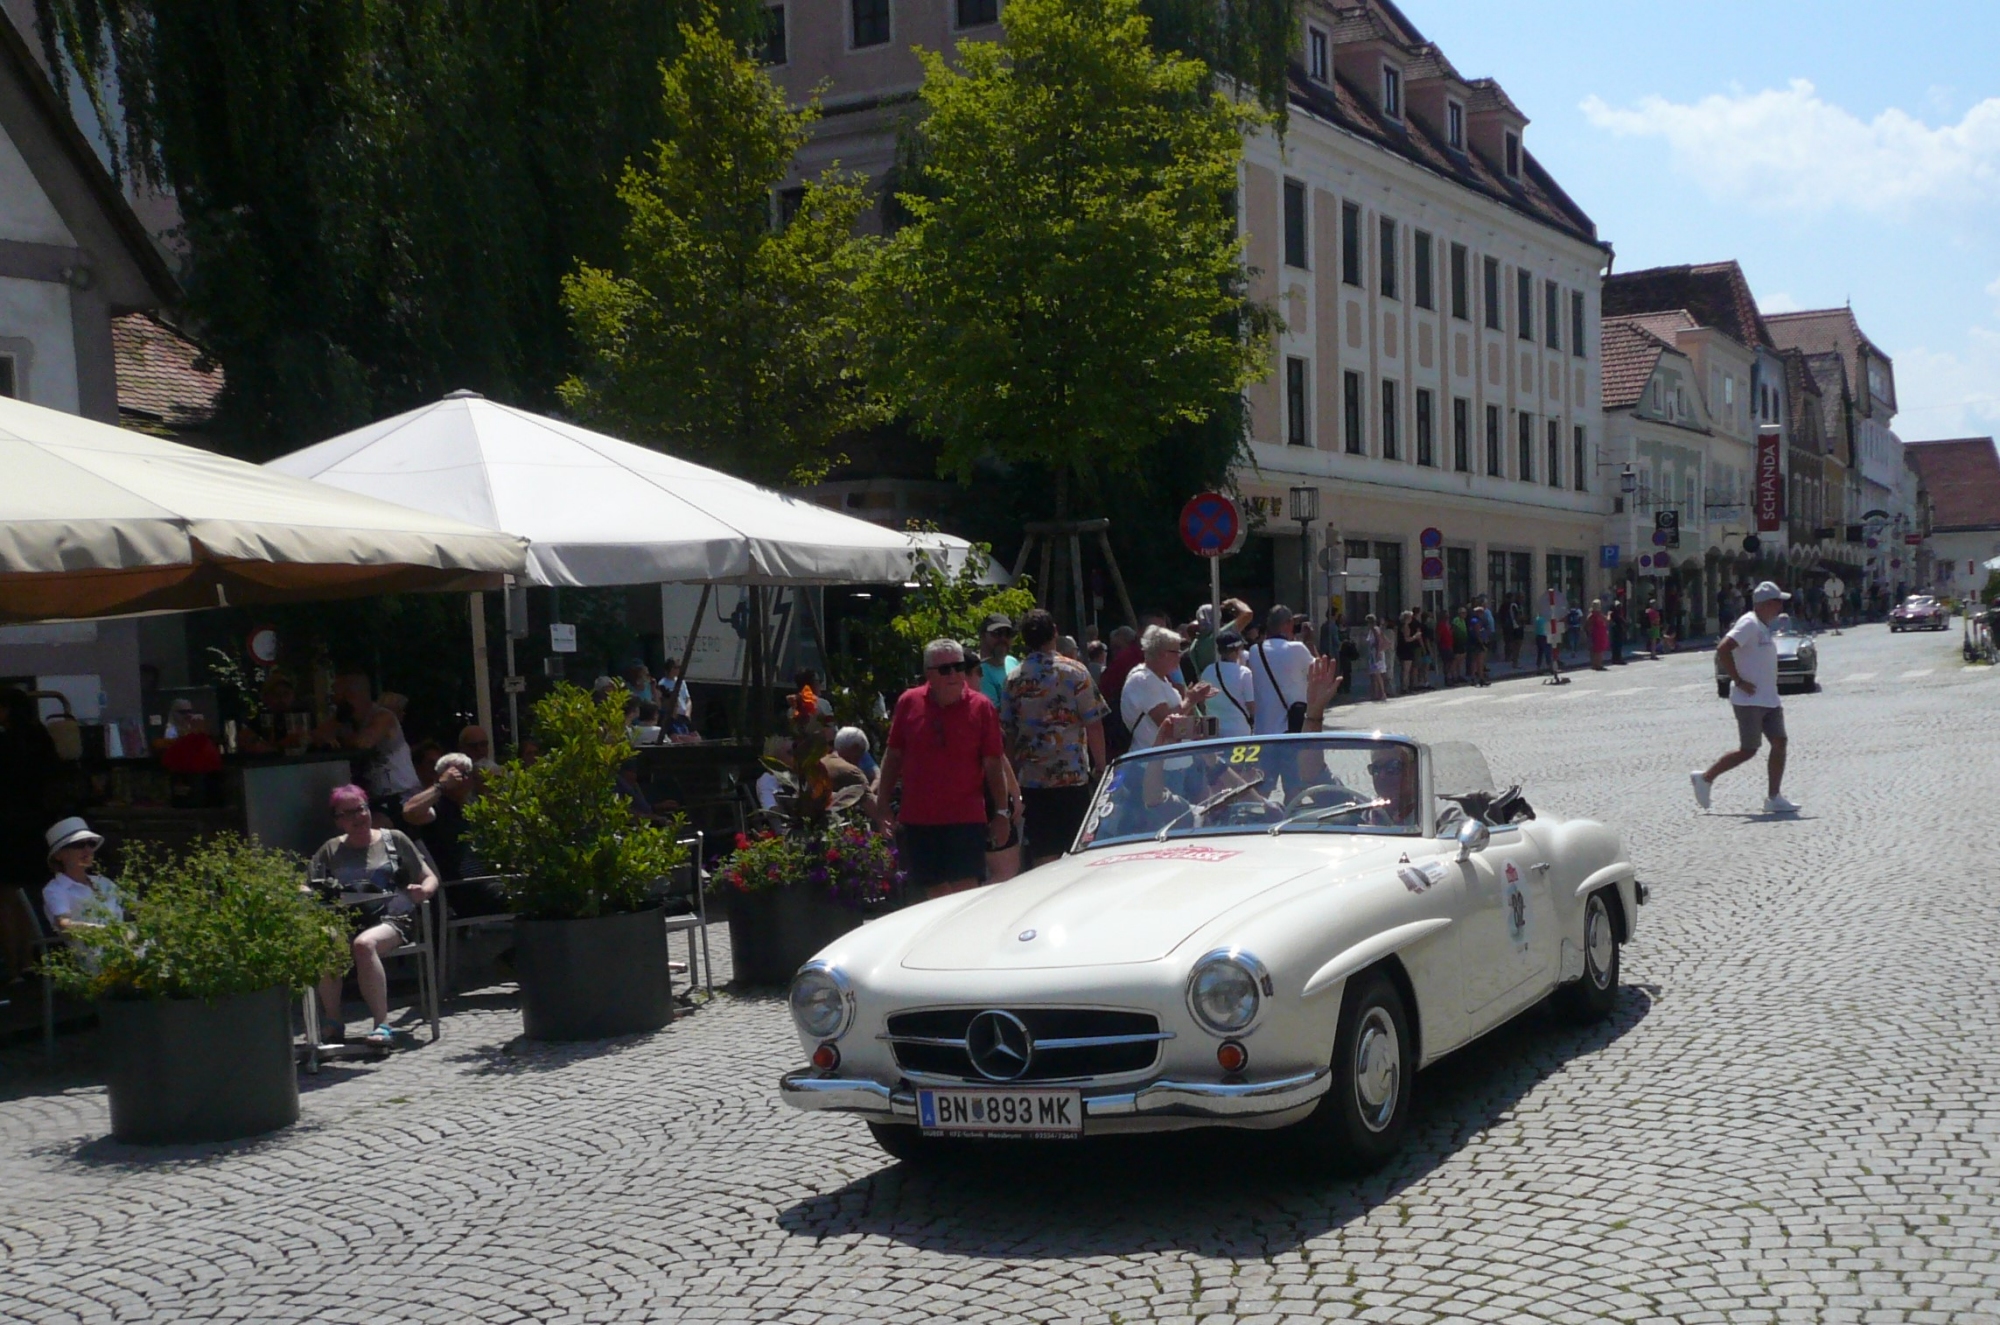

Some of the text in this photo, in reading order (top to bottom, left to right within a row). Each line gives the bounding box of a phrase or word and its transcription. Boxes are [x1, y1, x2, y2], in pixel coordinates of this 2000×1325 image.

[1762, 444, 1775, 520] SCHANDA
[1605, 548, 1614, 560] P
[1230, 744, 1260, 763] 82
[925, 1113, 932, 1121] A
[938, 1096, 1071, 1125] BN 893 MK
